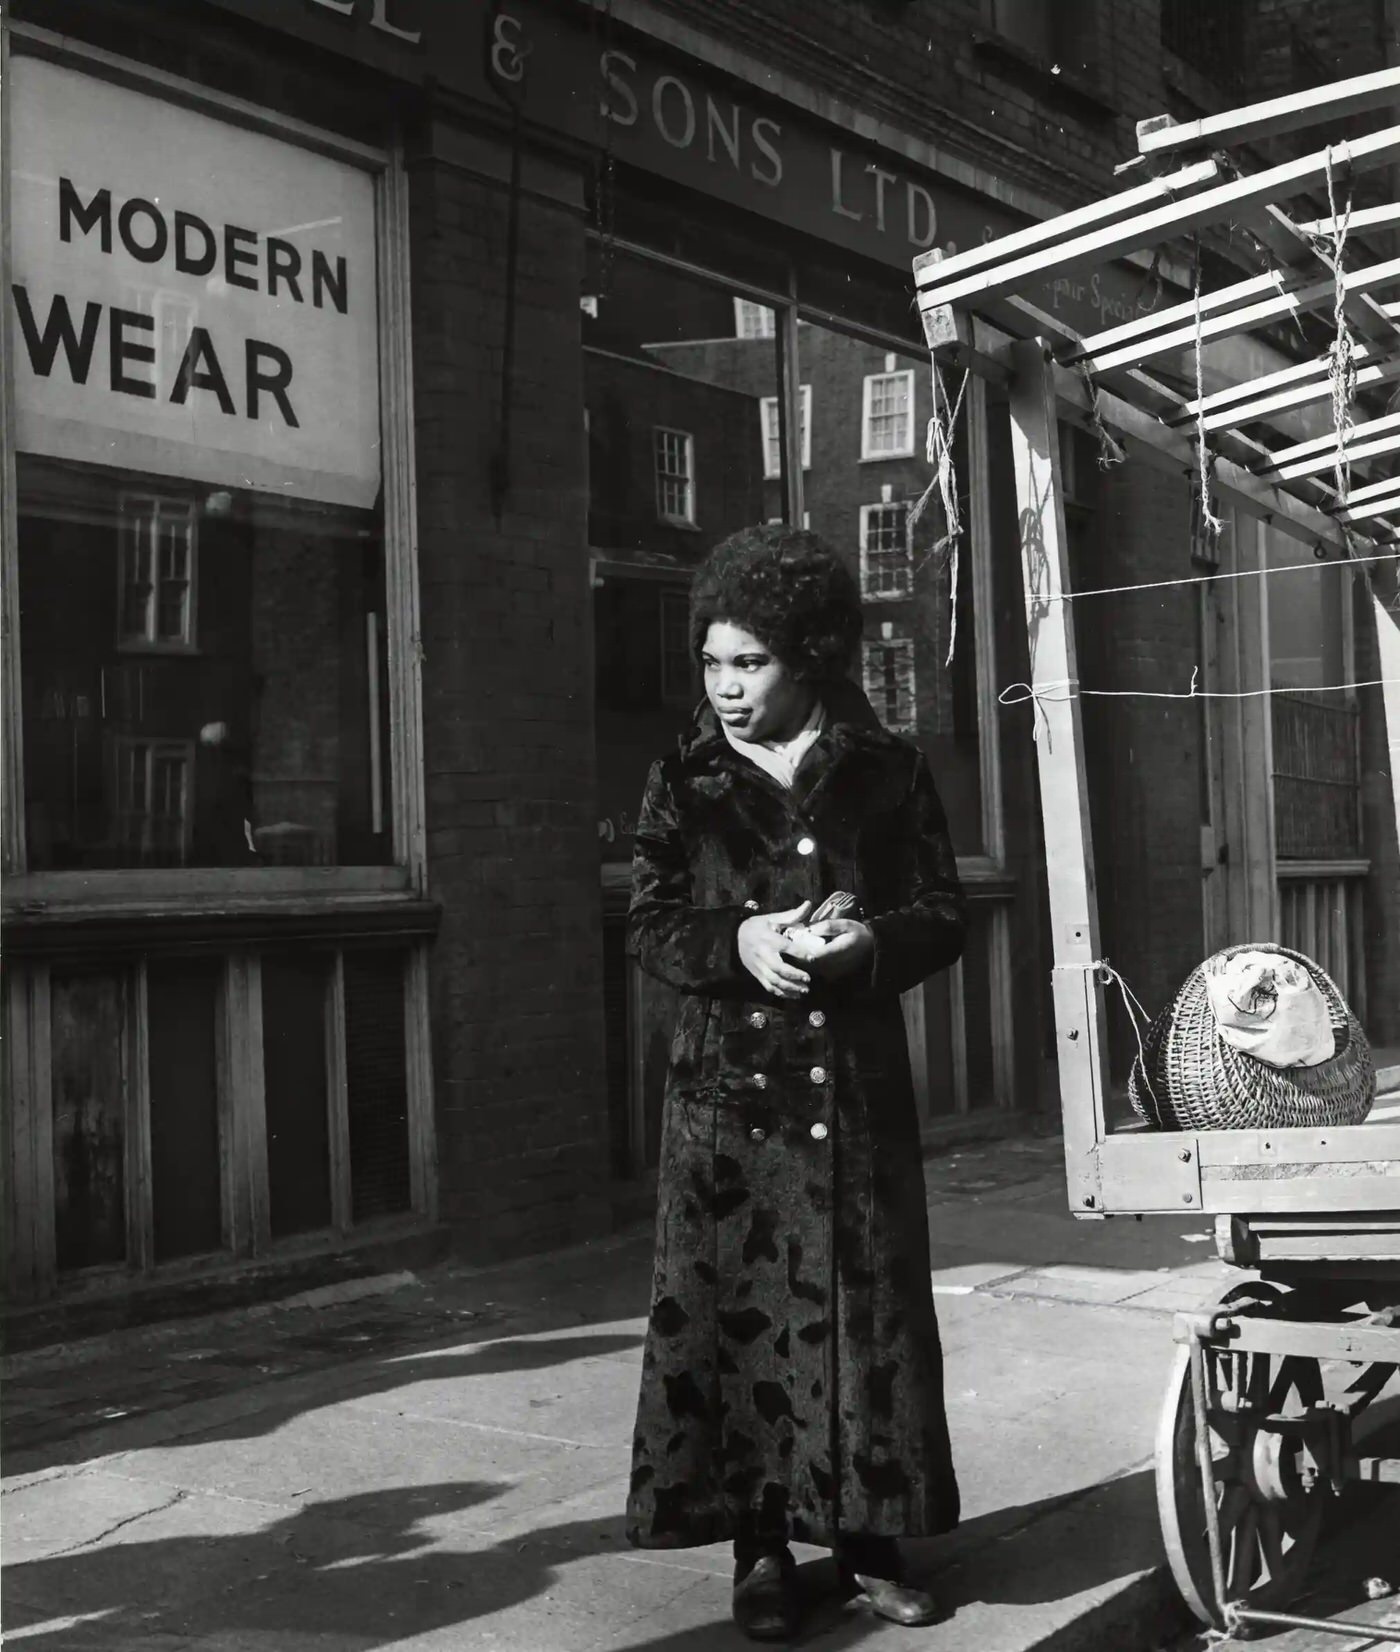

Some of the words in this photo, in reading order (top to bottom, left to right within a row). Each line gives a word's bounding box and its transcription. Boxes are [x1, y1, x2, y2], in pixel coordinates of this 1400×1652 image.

[491, 13, 533, 82] &
[599, 48, 783, 186] SONS
[58, 177, 348, 314] MODERN
[12, 284, 300, 428] WEAR
